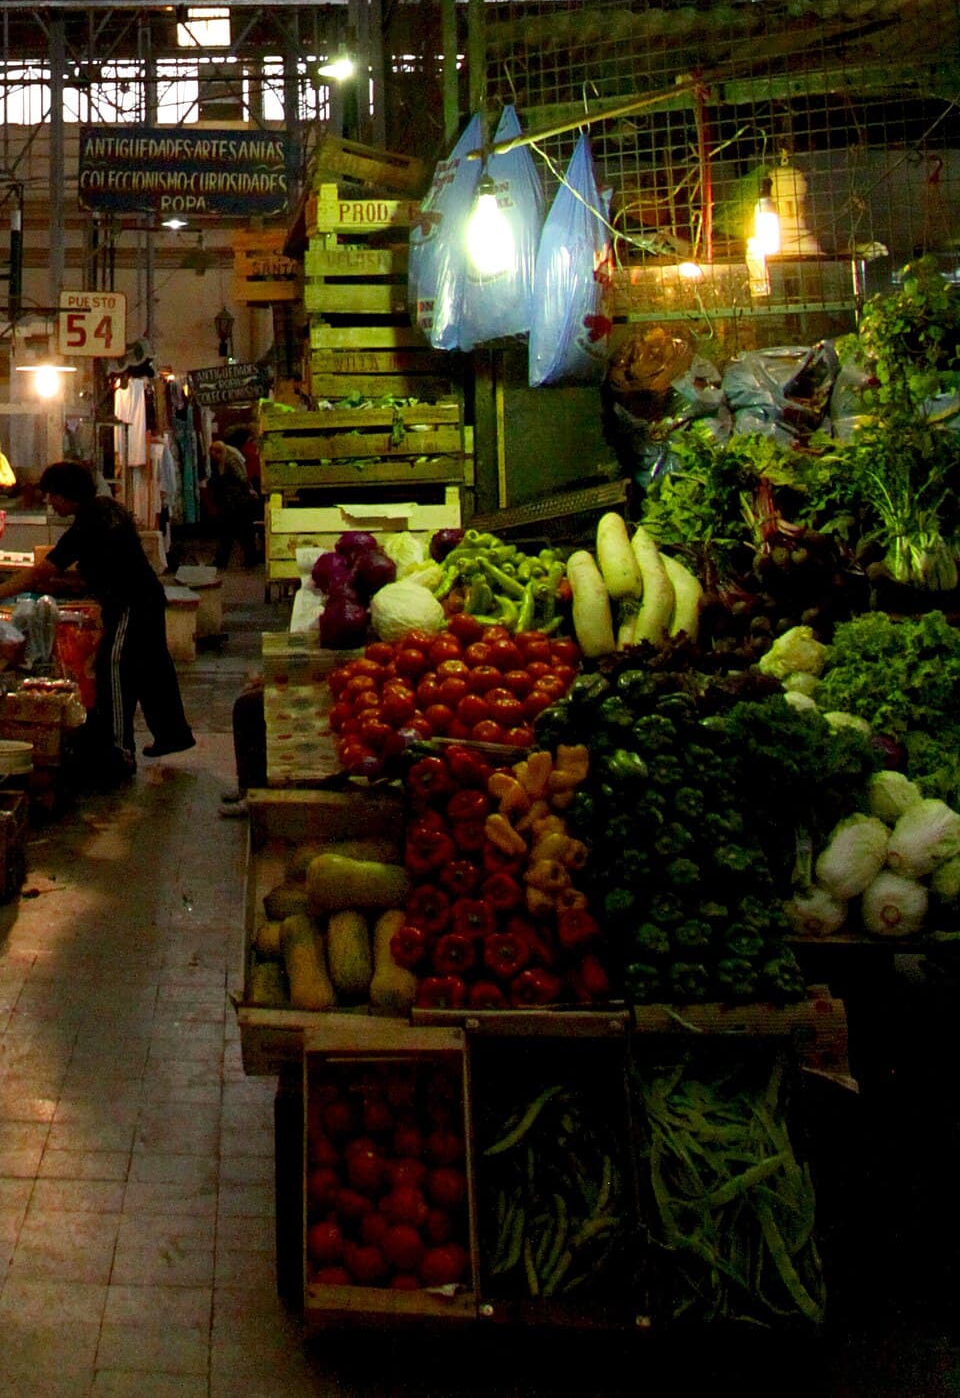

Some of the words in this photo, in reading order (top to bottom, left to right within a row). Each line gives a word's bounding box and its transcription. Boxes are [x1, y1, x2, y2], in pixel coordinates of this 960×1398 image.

[160, 195, 207, 212] ROPA
[68, 296, 116, 308] PUESTO
[66, 314, 113, 349] 54
